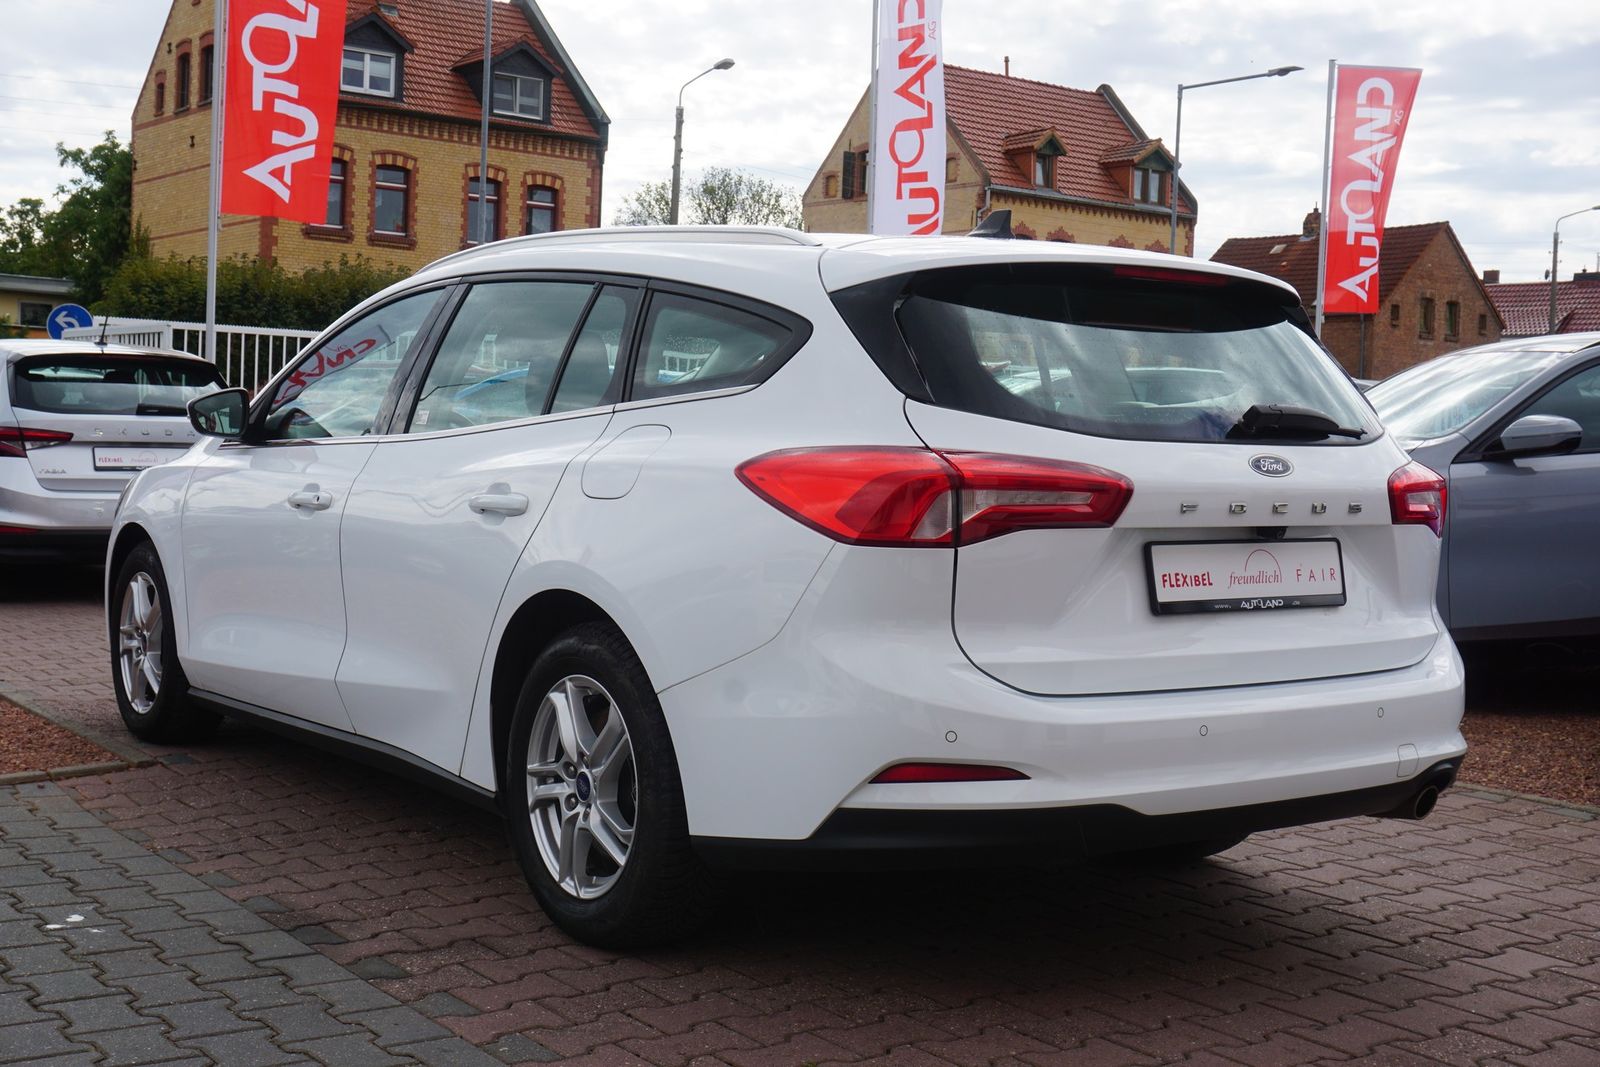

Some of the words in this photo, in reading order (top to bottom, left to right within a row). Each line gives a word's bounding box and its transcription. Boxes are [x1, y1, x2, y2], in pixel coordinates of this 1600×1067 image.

[927, 20, 937, 40] AG
[241, 0, 320, 204] AUTOL
[1393, 109, 1405, 127] AG
[1337, 76, 1398, 303] AUTOLAND
[1258, 457, 1284, 473] Ford
[1180, 502, 1363, 515] FOCUS
[1161, 571, 1213, 588] FLEXIBEL
[1227, 570, 1280, 589] freundlich
[1296, 567, 1337, 583] FAIR
[1240, 598, 1284, 609] AUTOLAND
